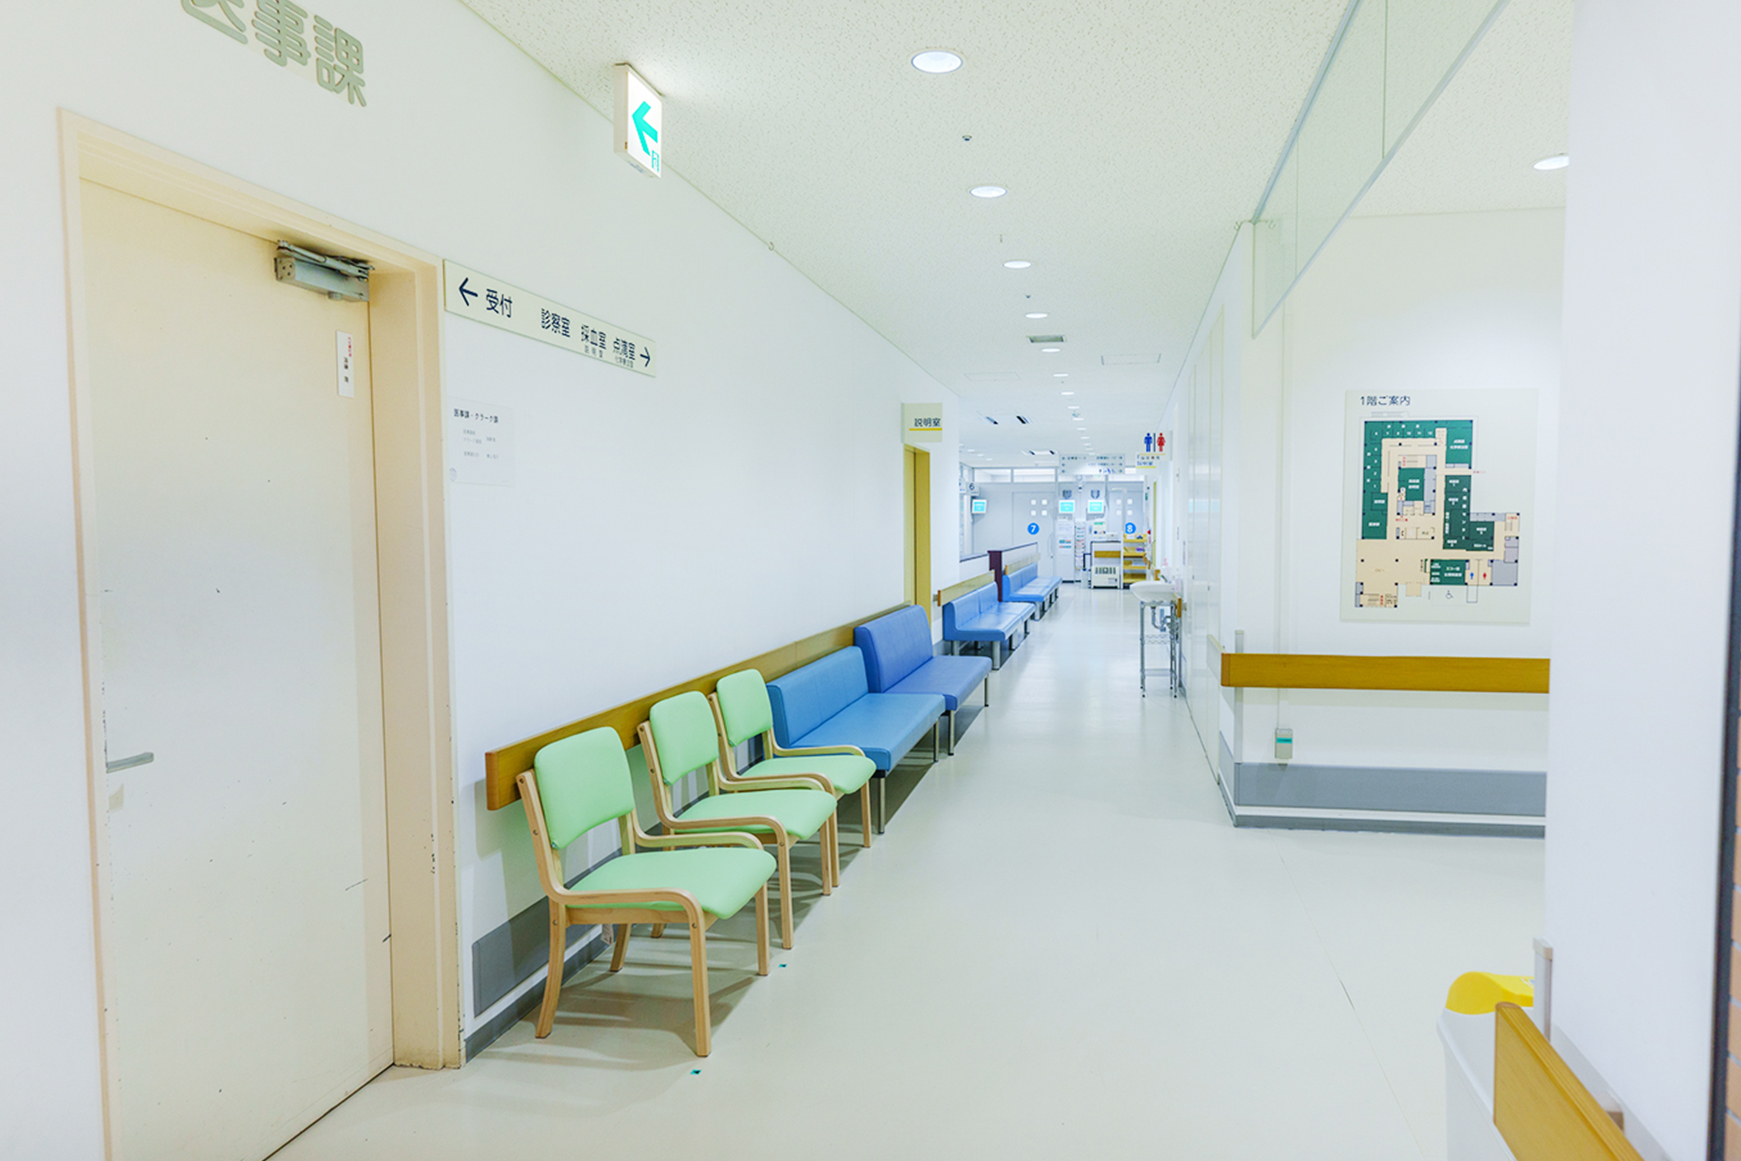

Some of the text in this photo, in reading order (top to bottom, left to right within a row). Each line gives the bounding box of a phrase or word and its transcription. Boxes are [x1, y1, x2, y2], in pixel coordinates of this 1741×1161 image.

[485, 288, 513, 319] 受付
[540, 308, 571, 338] 診察室
[581, 324, 606, 350] 採血室
[1361, 395, 1411, 406] 1階ご案内
[914, 417, 941, 427] 説明室
[969, 482, 975, 491] 6
